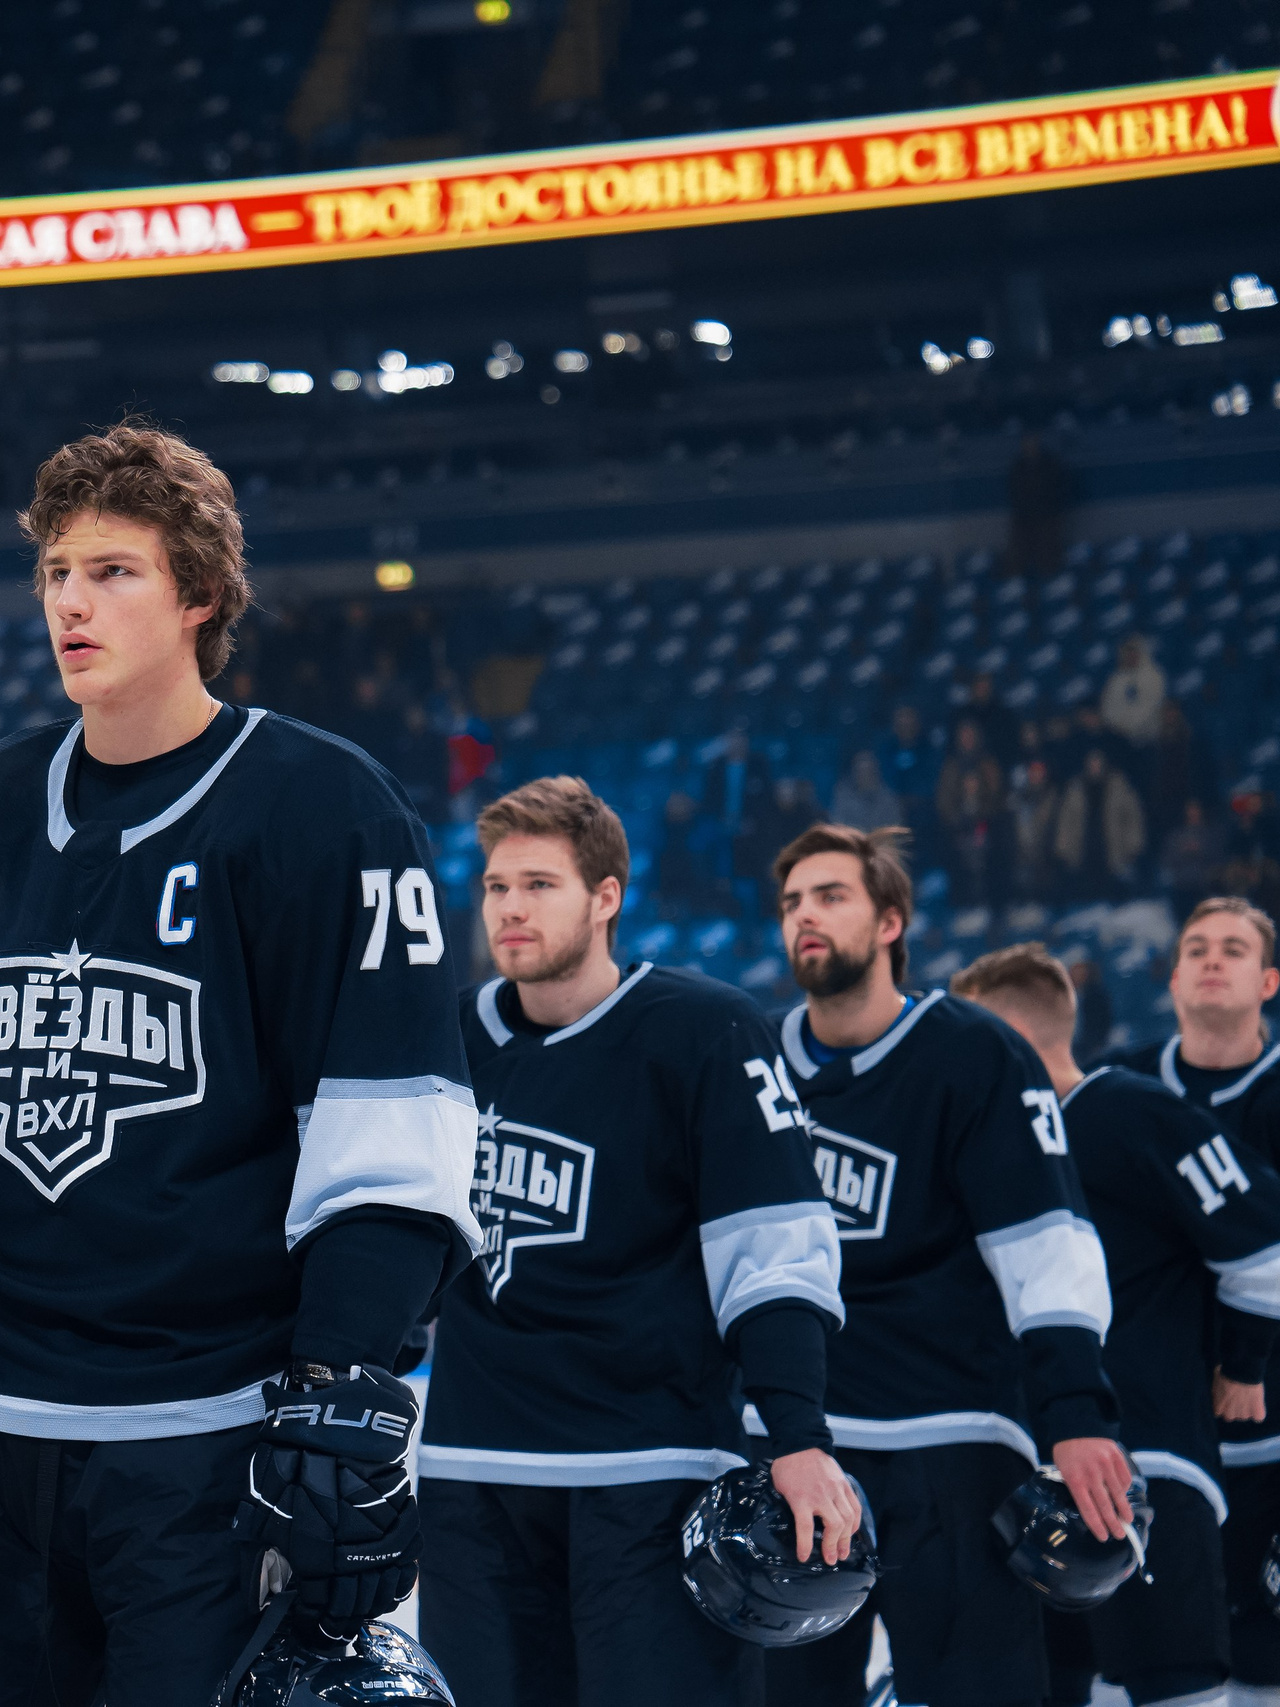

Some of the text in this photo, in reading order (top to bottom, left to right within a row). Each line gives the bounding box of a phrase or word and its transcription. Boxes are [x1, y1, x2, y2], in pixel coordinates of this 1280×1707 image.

[73, 203, 248, 261] СЛАВА
[446, 152, 768, 240] ДОСТОЯНЬЕ
[775, 145, 856, 198] НА
[863, 130, 970, 189] ВСЕ
[975, 95, 1248, 179] ВРЕМЕНА!
[156, 861, 199, 945] C
[359, 867, 445, 971] 79
[46, 1051, 71, 1079] И
[17, 1092, 97, 1138] ВХЛ
[1176, 1133, 1251, 1216] 14
[361, 1680, 411, 1690] AUER
